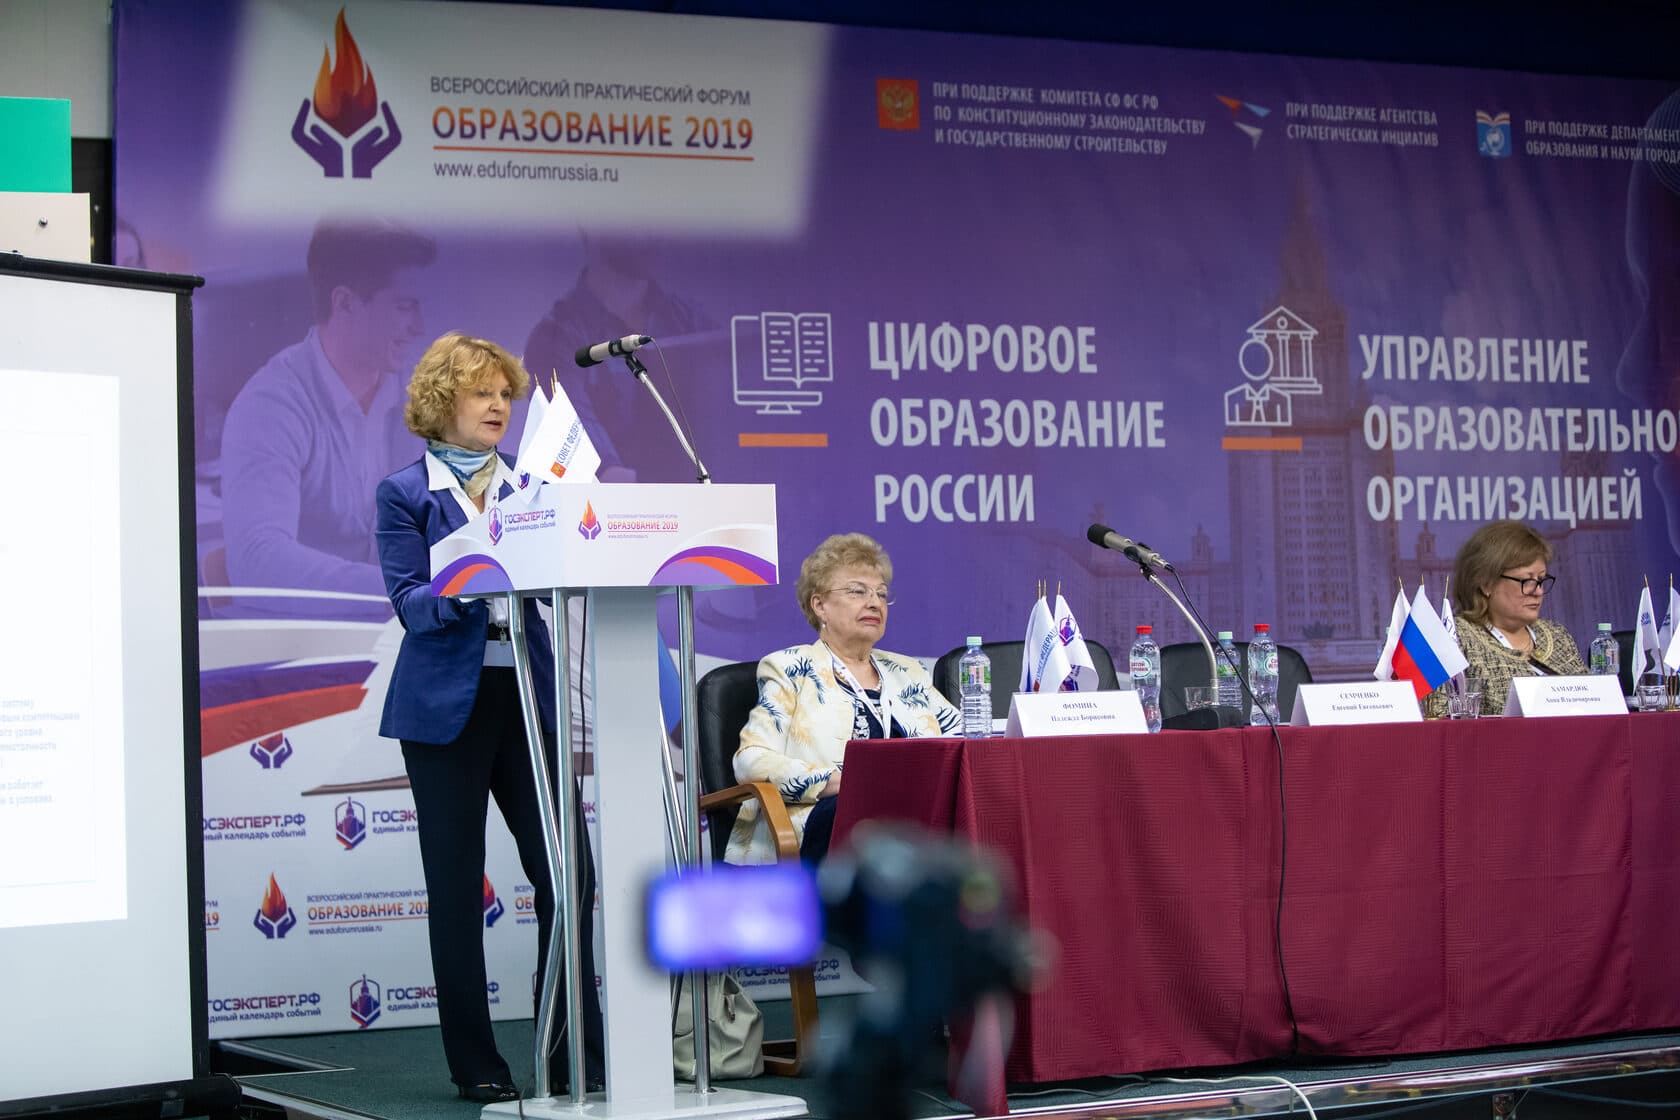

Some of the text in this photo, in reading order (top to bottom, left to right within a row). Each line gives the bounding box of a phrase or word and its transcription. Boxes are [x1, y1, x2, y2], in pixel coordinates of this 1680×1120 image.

[430, 76, 751, 106] ВСЕРОССИЙСКИЙ ПРАКТИЧЕСКИЙ ФОРУМ
[932, 81, 958, 98] ПРИ
[961, 84, 1034, 104] ПОДДЕРЖКЕ
[1040, 88, 1102, 107] КОМИТЕТА
[1142, 95, 1159, 110] РФ
[933, 105, 1206, 135] ПО КОНСТИТУЦИОННОМУ ЗАКОНОДАТЕЛЬСТВУ
[1285, 102, 1439, 127] ПРИ ПОДДЕРЖКЕ АГЕНТСТВА
[432, 105, 754, 150] ОБРАЗОВАНИЕ 2019
[1286, 124, 1379, 144] СТРАТЕГИЧЕСКИХ
[1524, 119, 1546, 134] ПРИ
[1548, 121, 1609, 138] ПОДДЕРЖКЕ
[935, 128, 1169, 155] И ГОСУДАРСТВЕННОМУ СТРОИТЕЛЬСТВУ
[1525, 140, 1598, 158] ОБРАЗОВАНИЯ
[1600, 145, 1609, 158] И
[1610, 147, 1644, 160] НАУКИ
[434, 159, 620, 183] www.eduforumrussia.ru
[868, 320, 1098, 381] ЦИФРОВОЕ
[1358, 334, 1591, 384] УПРАВЛЕНИЕ
[870, 397, 1166, 448] ОБРАЗОВАНИЕ
[1363, 404, 1680, 453] ОБРАЗОВАТЕЛЬНО
[874, 473, 1035, 523] РОССИИ
[1366, 468, 1643, 530] ОРГАНИЗАЦИЕЙ
[607, 520, 679, 530] ОБРАЗОВАНИЕ 2019
[224, 831, 270, 841] календарь
[271, 829, 307, 839] событий
[307, 892, 363, 904] ВСЕРОССИЙСКИЙ
[363, 889, 413, 899] ПРАКТИЧЕСКИЙ
[307, 900, 429, 921] ОБРАЗОВАНИЕ 201
[308, 925, 383, 936] www.eduforumrussia.ru
[239, 1011, 285, 1022] календарь
[286, 1008, 321, 1018] событий
[387, 1002, 419, 1013] единый
